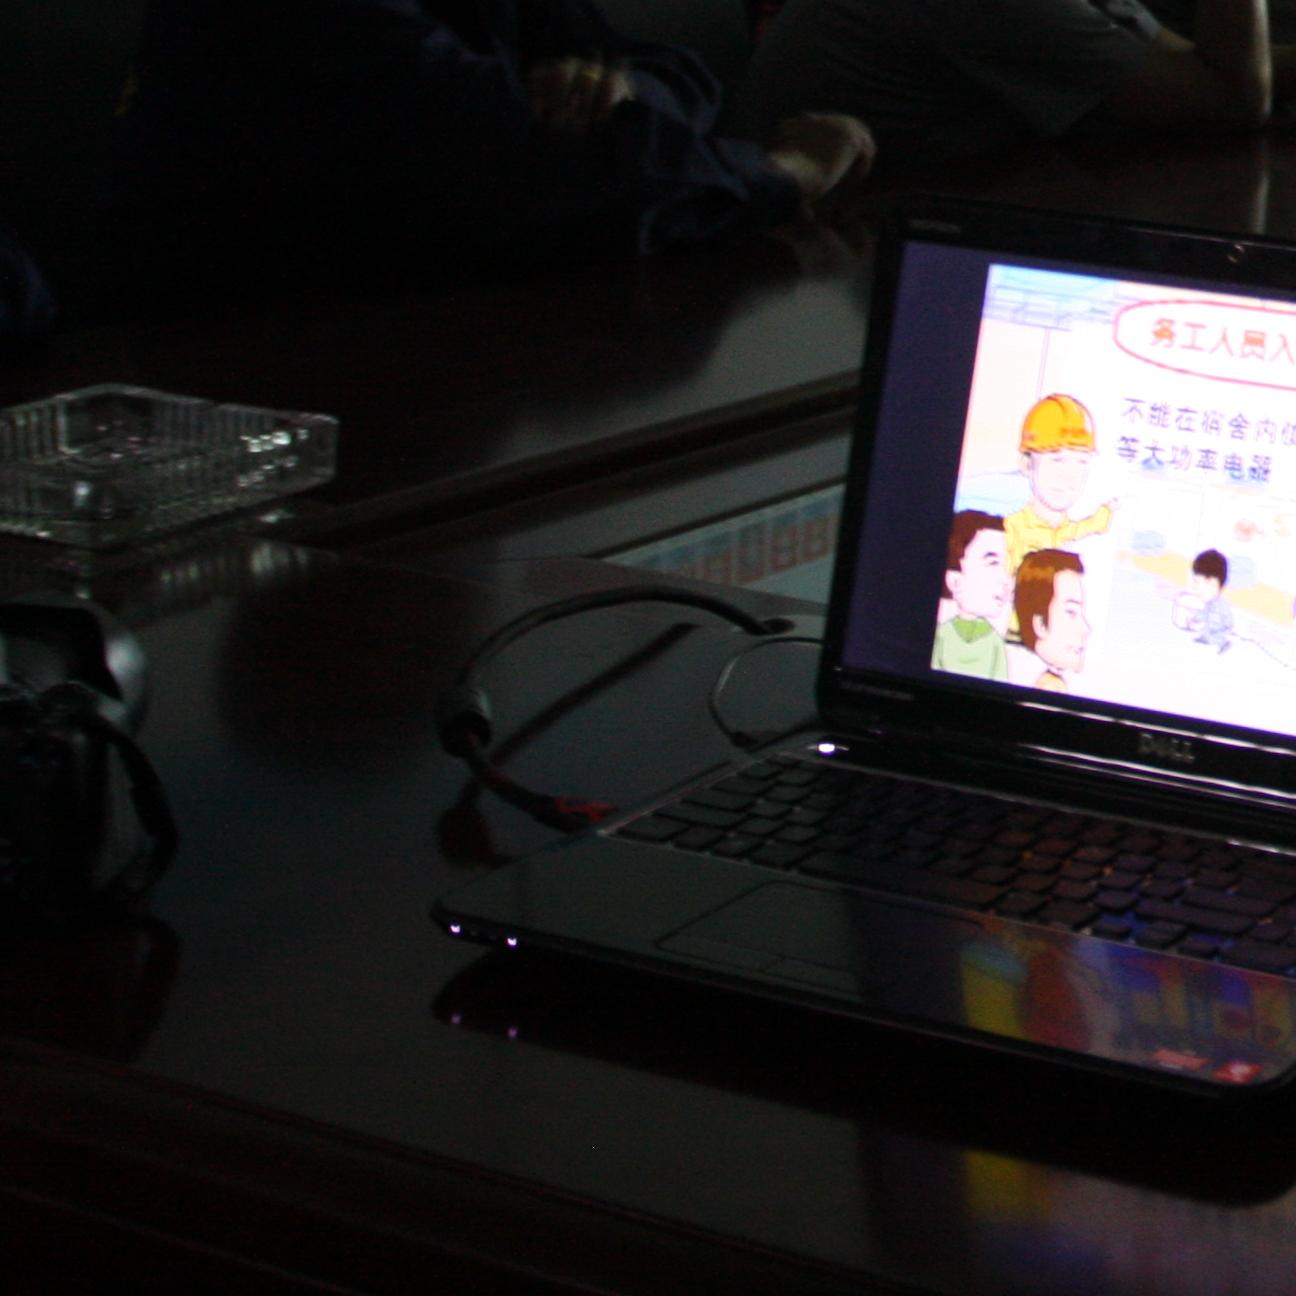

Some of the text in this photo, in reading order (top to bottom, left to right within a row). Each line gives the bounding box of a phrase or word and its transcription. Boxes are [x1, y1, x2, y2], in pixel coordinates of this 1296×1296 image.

[1116, 435, 1273, 484] 等大功率电器
